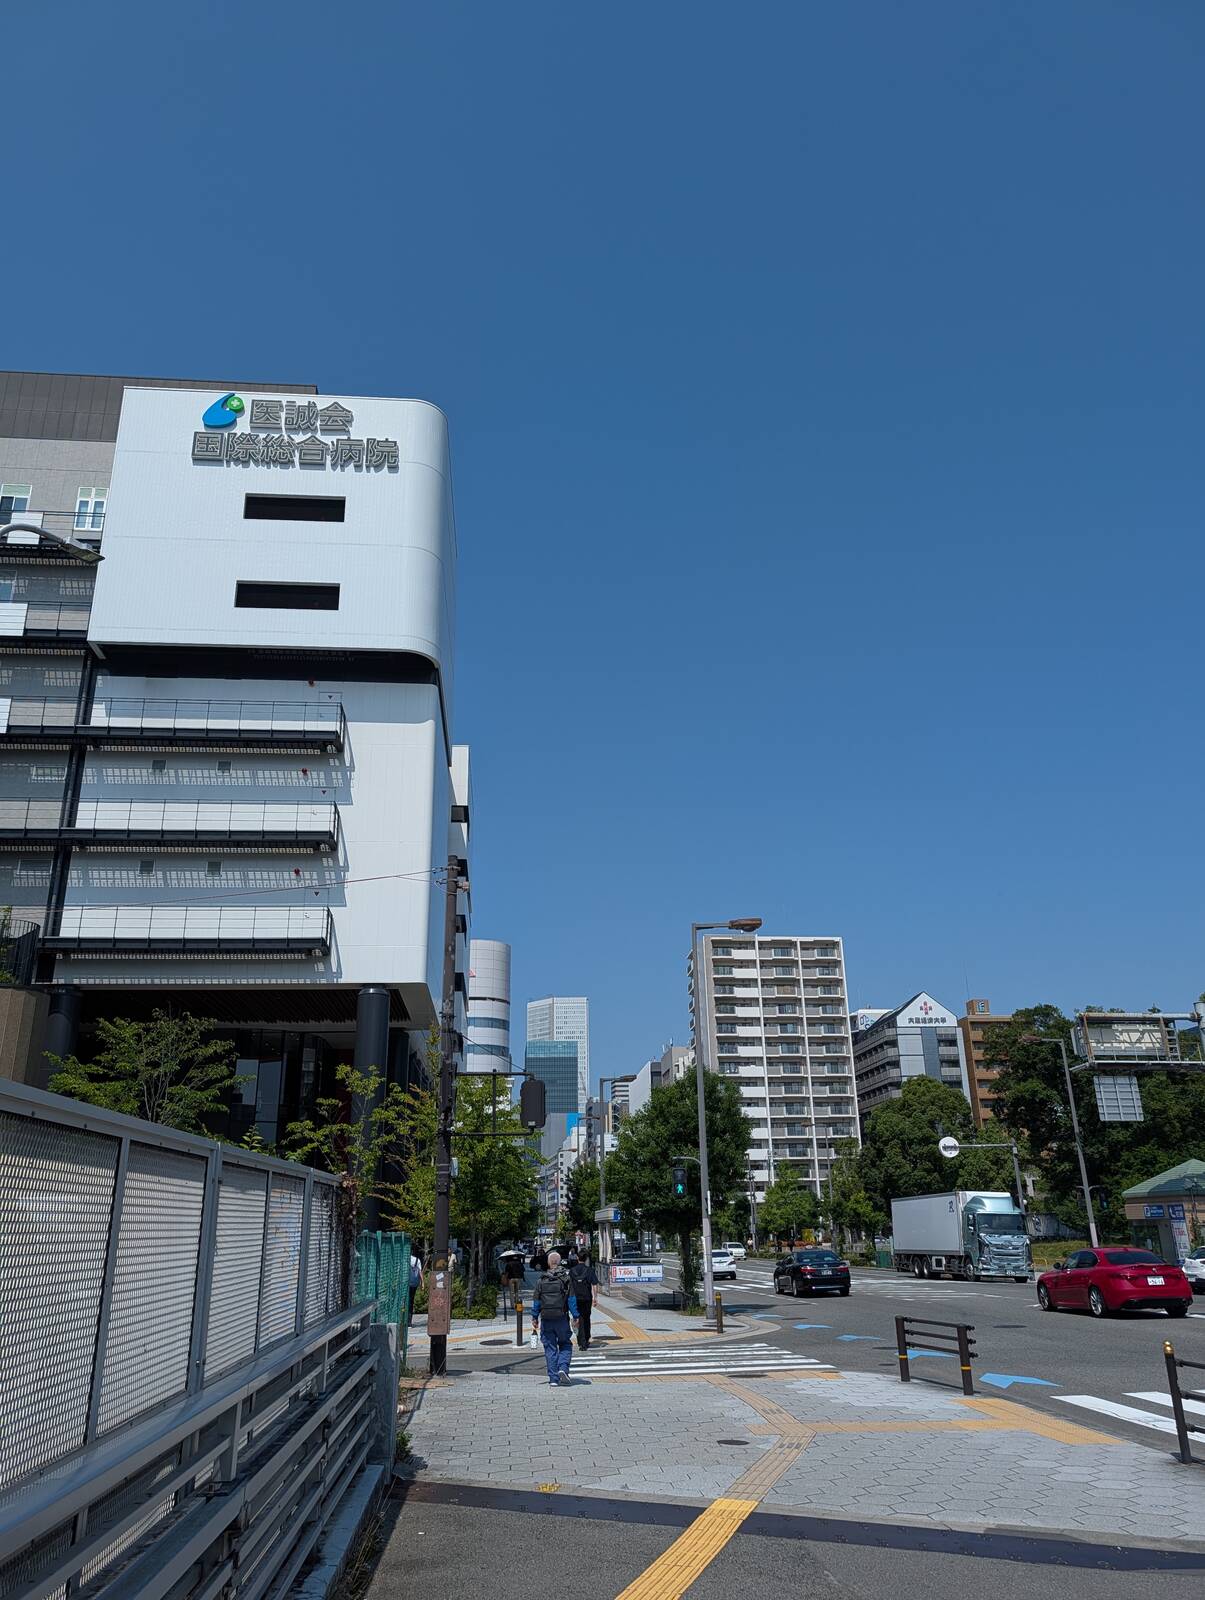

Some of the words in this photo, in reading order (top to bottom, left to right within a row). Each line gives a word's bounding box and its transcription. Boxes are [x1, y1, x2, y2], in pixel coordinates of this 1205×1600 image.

[249, 399, 354, 432] 医誠会
[191, 431, 400, 468] 国際総合病院
